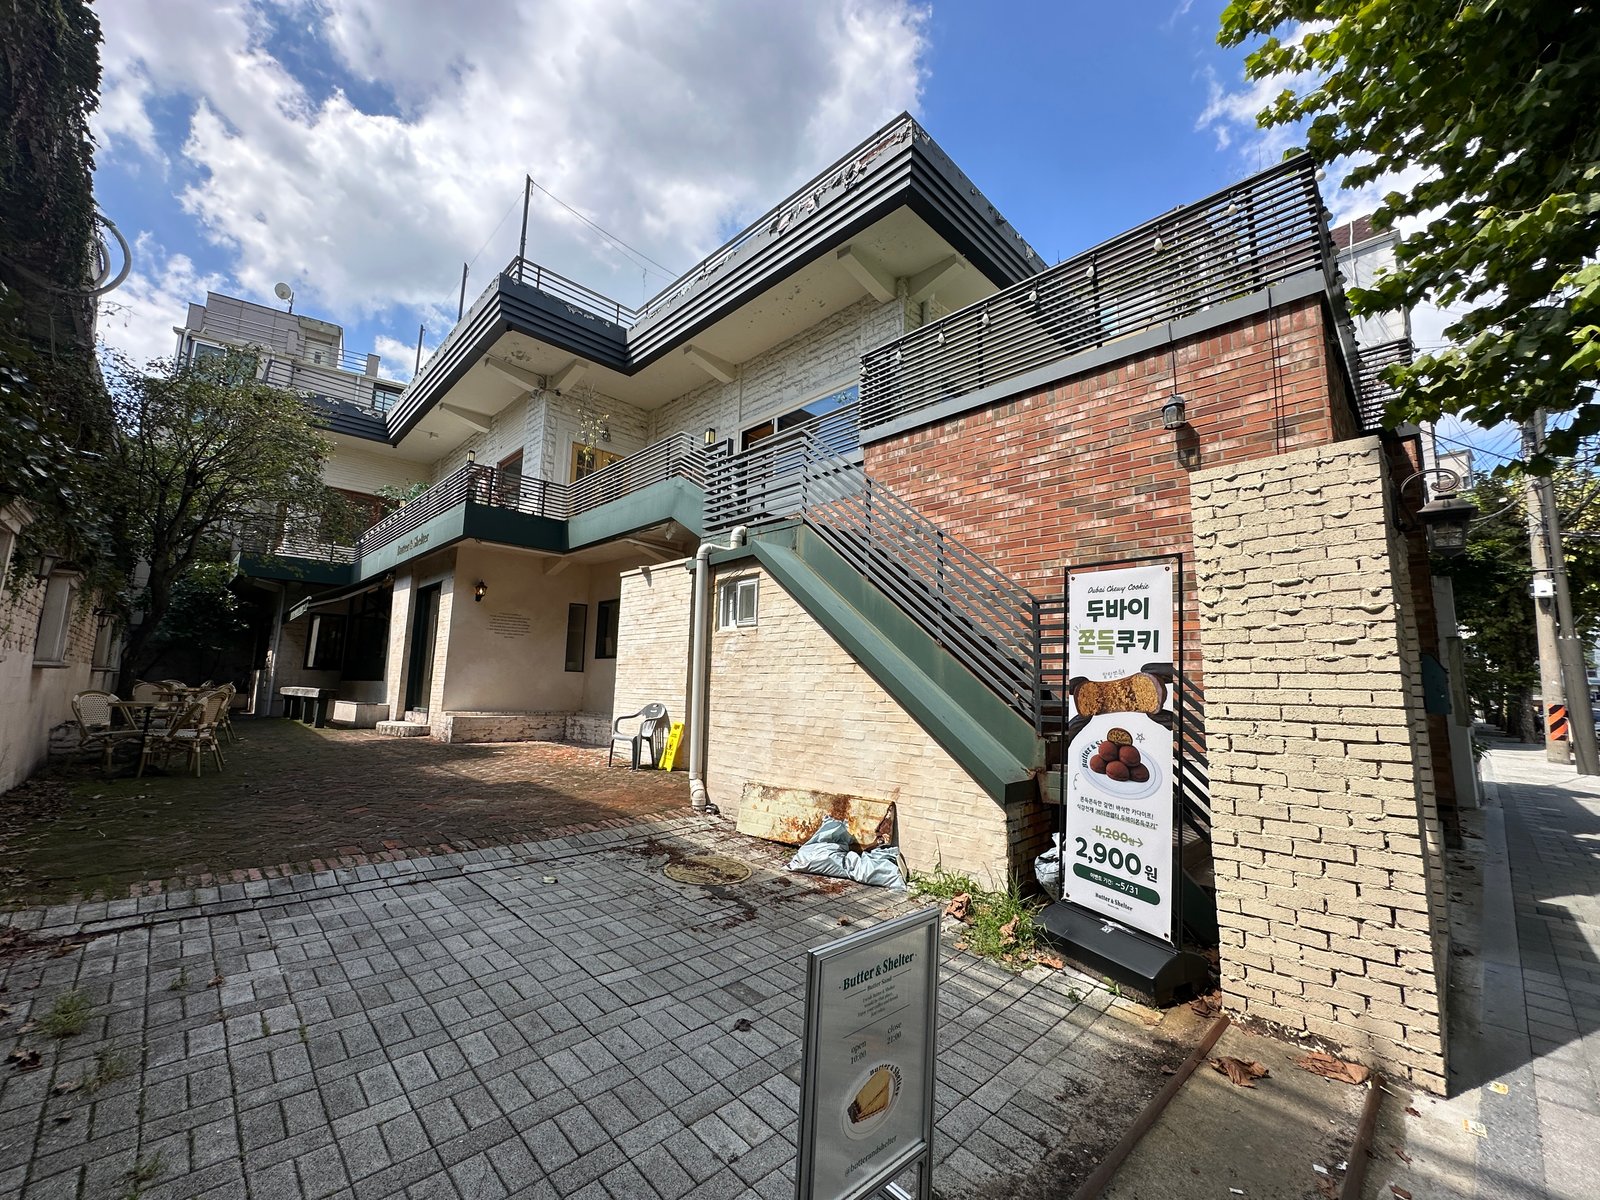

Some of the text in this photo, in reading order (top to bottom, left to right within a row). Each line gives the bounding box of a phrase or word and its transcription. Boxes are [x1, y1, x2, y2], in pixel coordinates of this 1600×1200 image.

[1107, 585, 1125, 593] Chewy
[1128, 582, 1149, 590] Cookie
[1087, 597, 1149, 622] 두바이
[1078, 630, 1159, 655] 쫀득쿠키
[1075, 836, 1158, 883] 2,900 원
[1089, 872, 1102, 881] 이벤트
[1115, 882, 1139, 895] ~5/31
[1095, 892, 1110, 902] Butter
[1115, 899, 1133, 911] Shelter
[843, 953, 914, 990] Butter & Shelter
[888, 1022, 902, 1034] close
[851, 1040, 867, 1054] open
